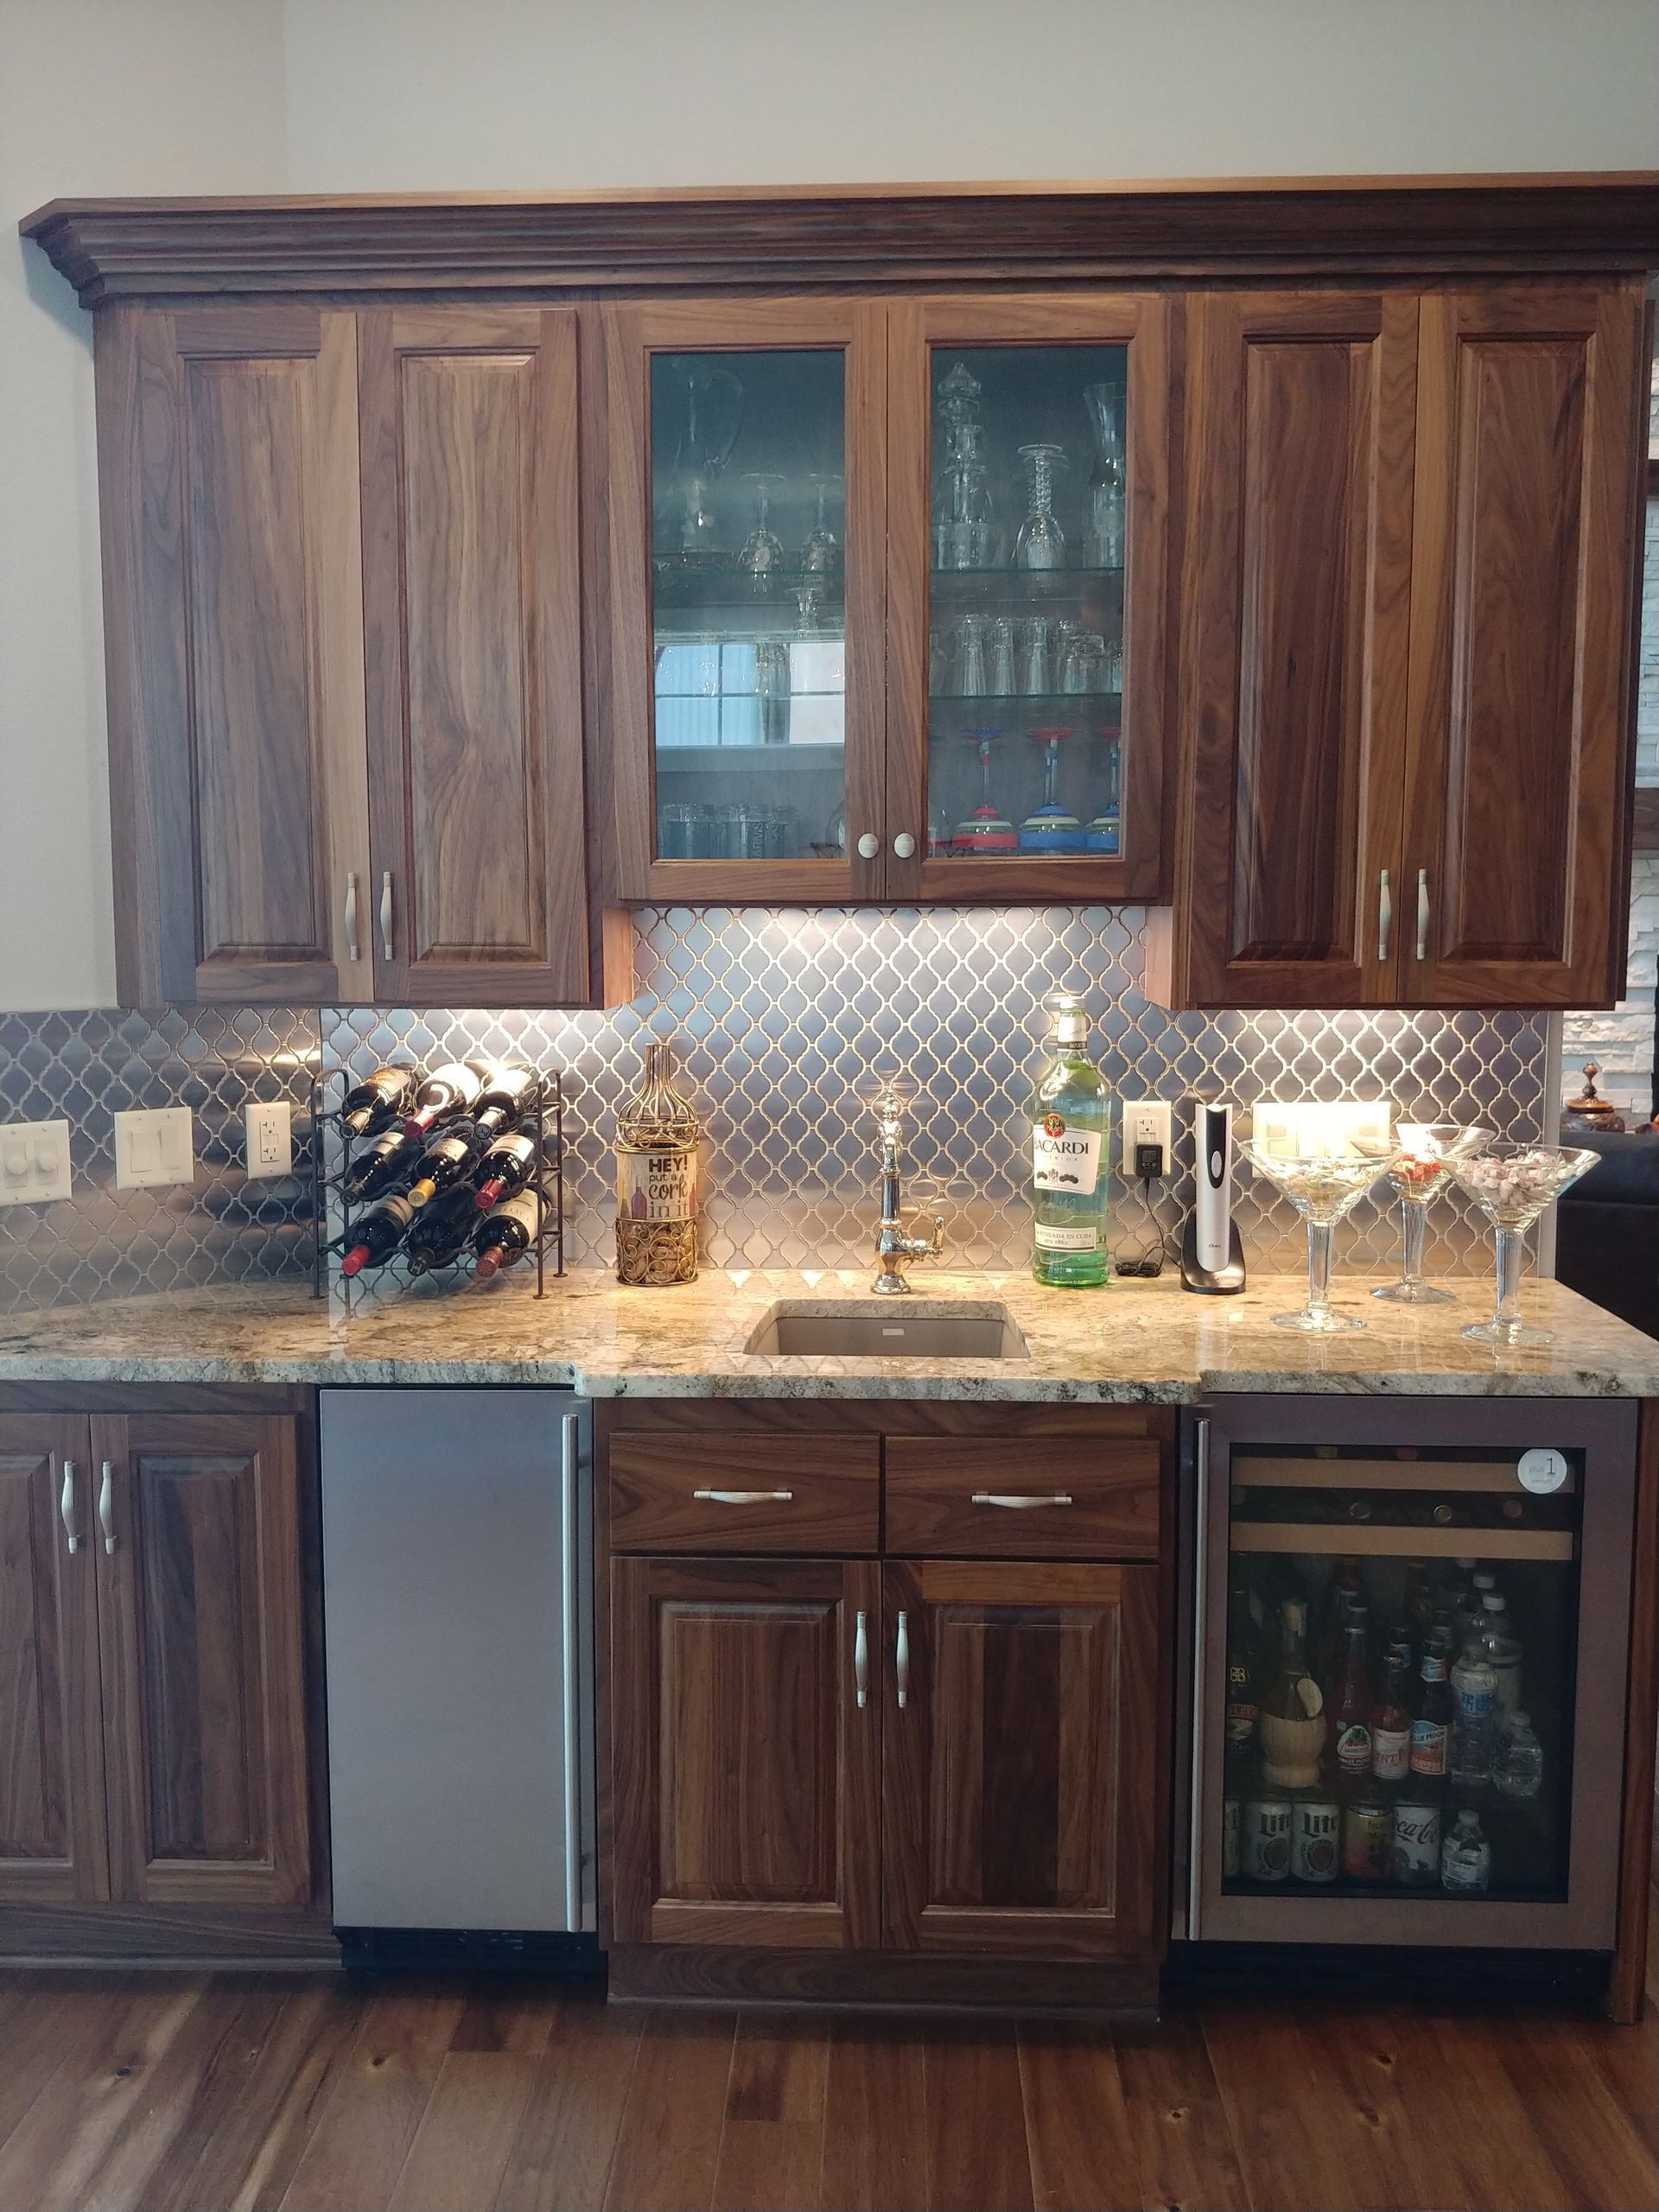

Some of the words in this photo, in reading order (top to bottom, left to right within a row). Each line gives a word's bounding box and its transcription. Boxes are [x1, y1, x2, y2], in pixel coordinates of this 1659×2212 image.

[1034, 1137, 1089, 1154] BACARDI
[649, 1154, 688, 1173] HEY!
[649, 1173, 668, 1185] put
[649, 1173, 689, 1200] cork
[648, 1201, 670, 1218] in
[677, 1199, 689, 1217] it
[1546, 1456, 1556, 1475] 1
